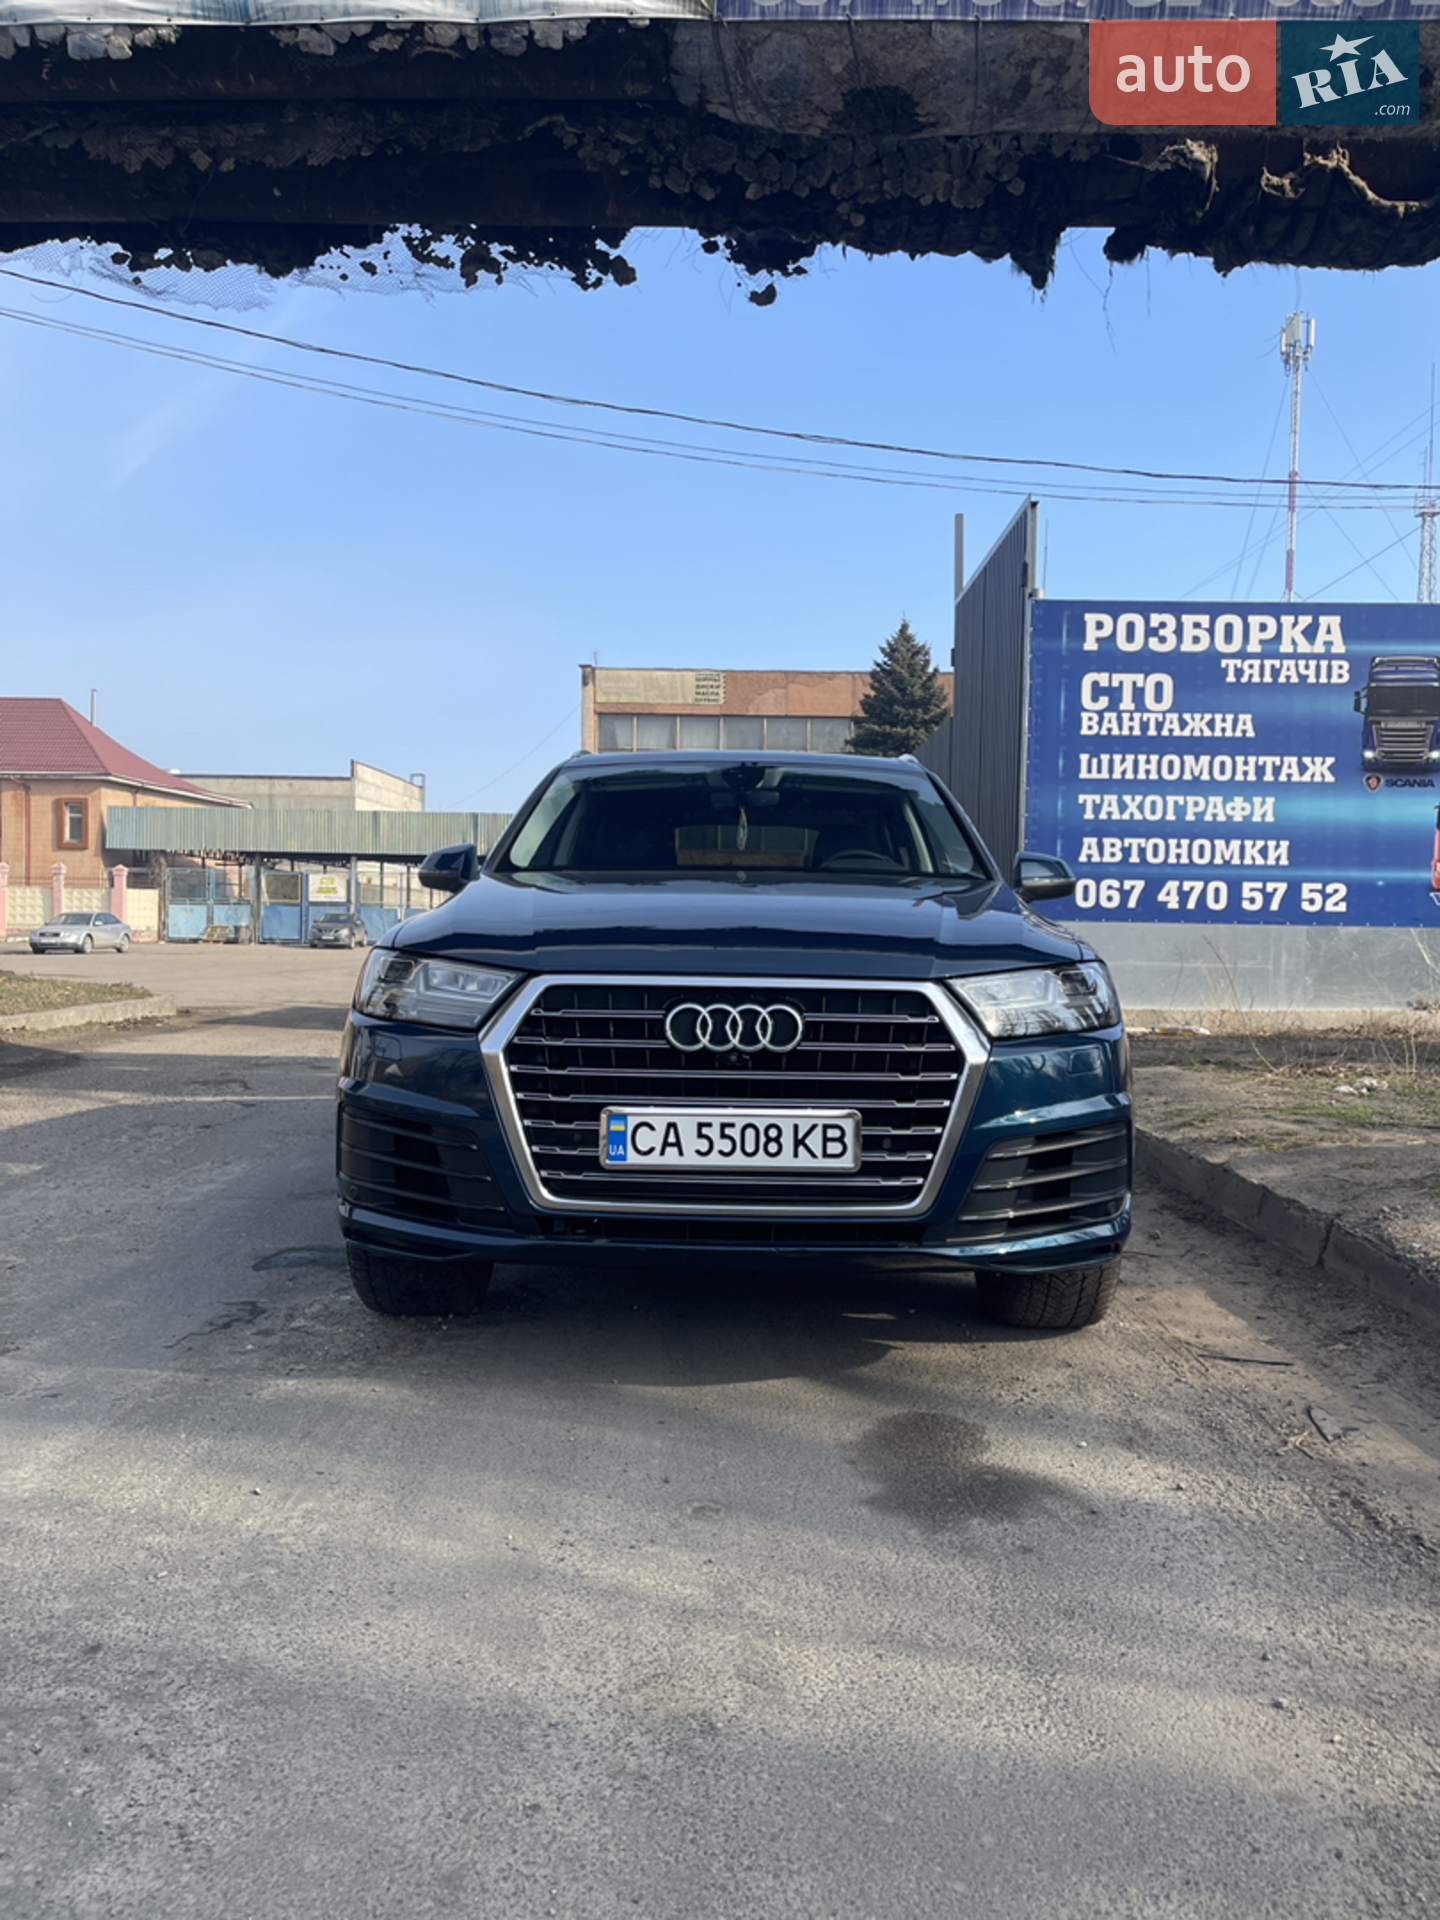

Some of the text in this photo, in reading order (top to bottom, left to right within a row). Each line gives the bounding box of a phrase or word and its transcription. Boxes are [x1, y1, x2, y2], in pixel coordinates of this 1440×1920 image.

[1083, 613, 1346, 654] РОЗБОРКА
[1220, 659, 1351, 684] ТЯГАЧІВ
[1080, 672, 1174, 712] СТО
[1079, 712, 1256, 738] ВАНТАЖНА
[1078, 753, 1336, 782] ШИНОМОНТАЖ
[1385, 778, 1435, 788] SCANIA
[1078, 794, 1276, 822] ТАХОГРАФИ
[1078, 837, 1290, 866] АВТОНОМКИ
[1074, 878, 1348, 913] 067 470 57 52
[608, 1144, 626, 1157] UA
[630, 1121, 849, 1160] CA 5508 KB
